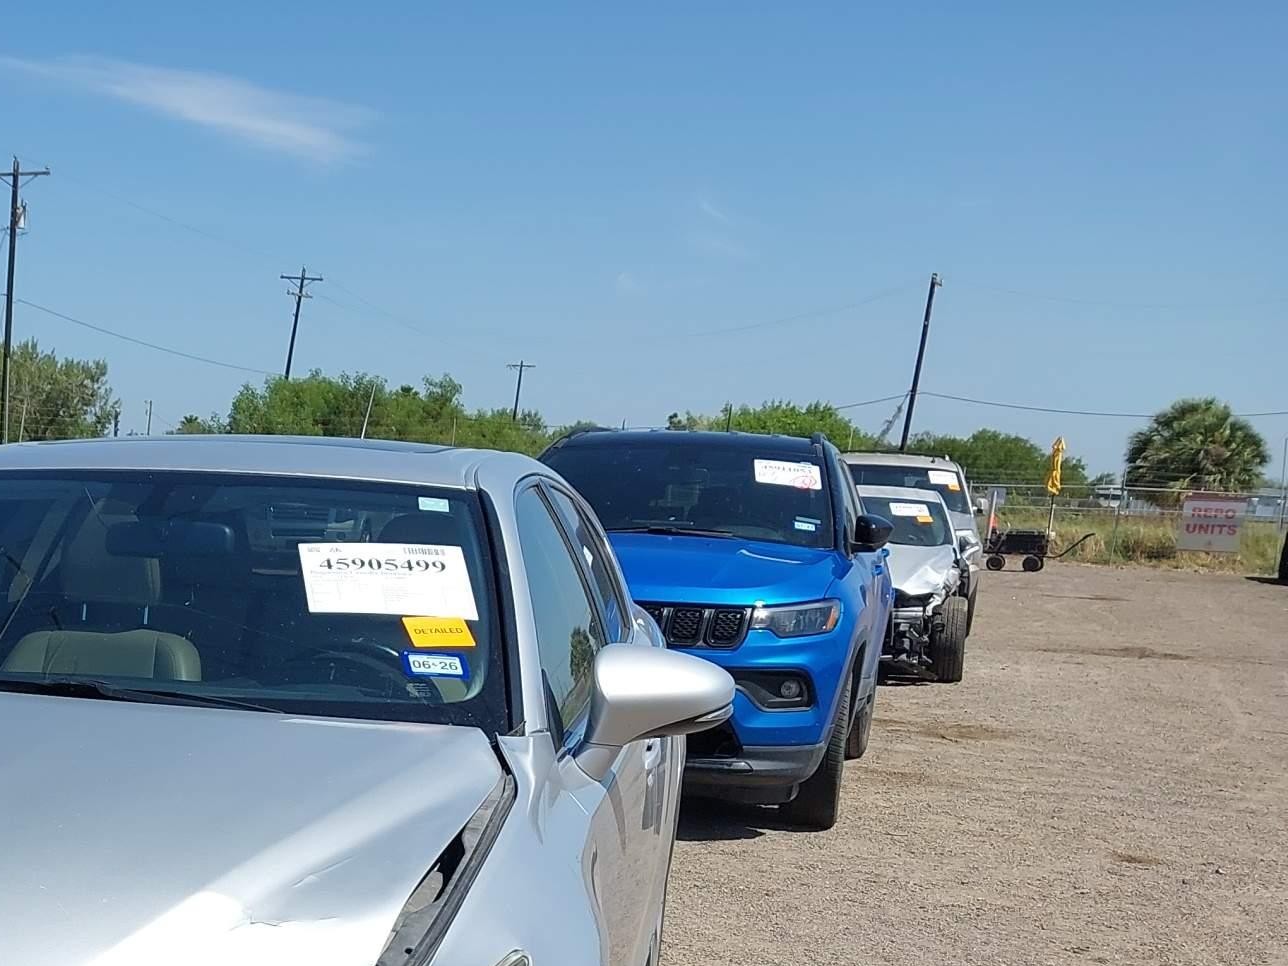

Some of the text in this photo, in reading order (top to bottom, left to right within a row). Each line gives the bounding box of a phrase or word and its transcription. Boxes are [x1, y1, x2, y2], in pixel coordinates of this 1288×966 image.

[1191, 506, 1236, 520] REPO
[1185, 523, 1237, 536] UNITS
[319, 557, 447, 574] 45905499
[413, 626, 464, 636] DETAILED
